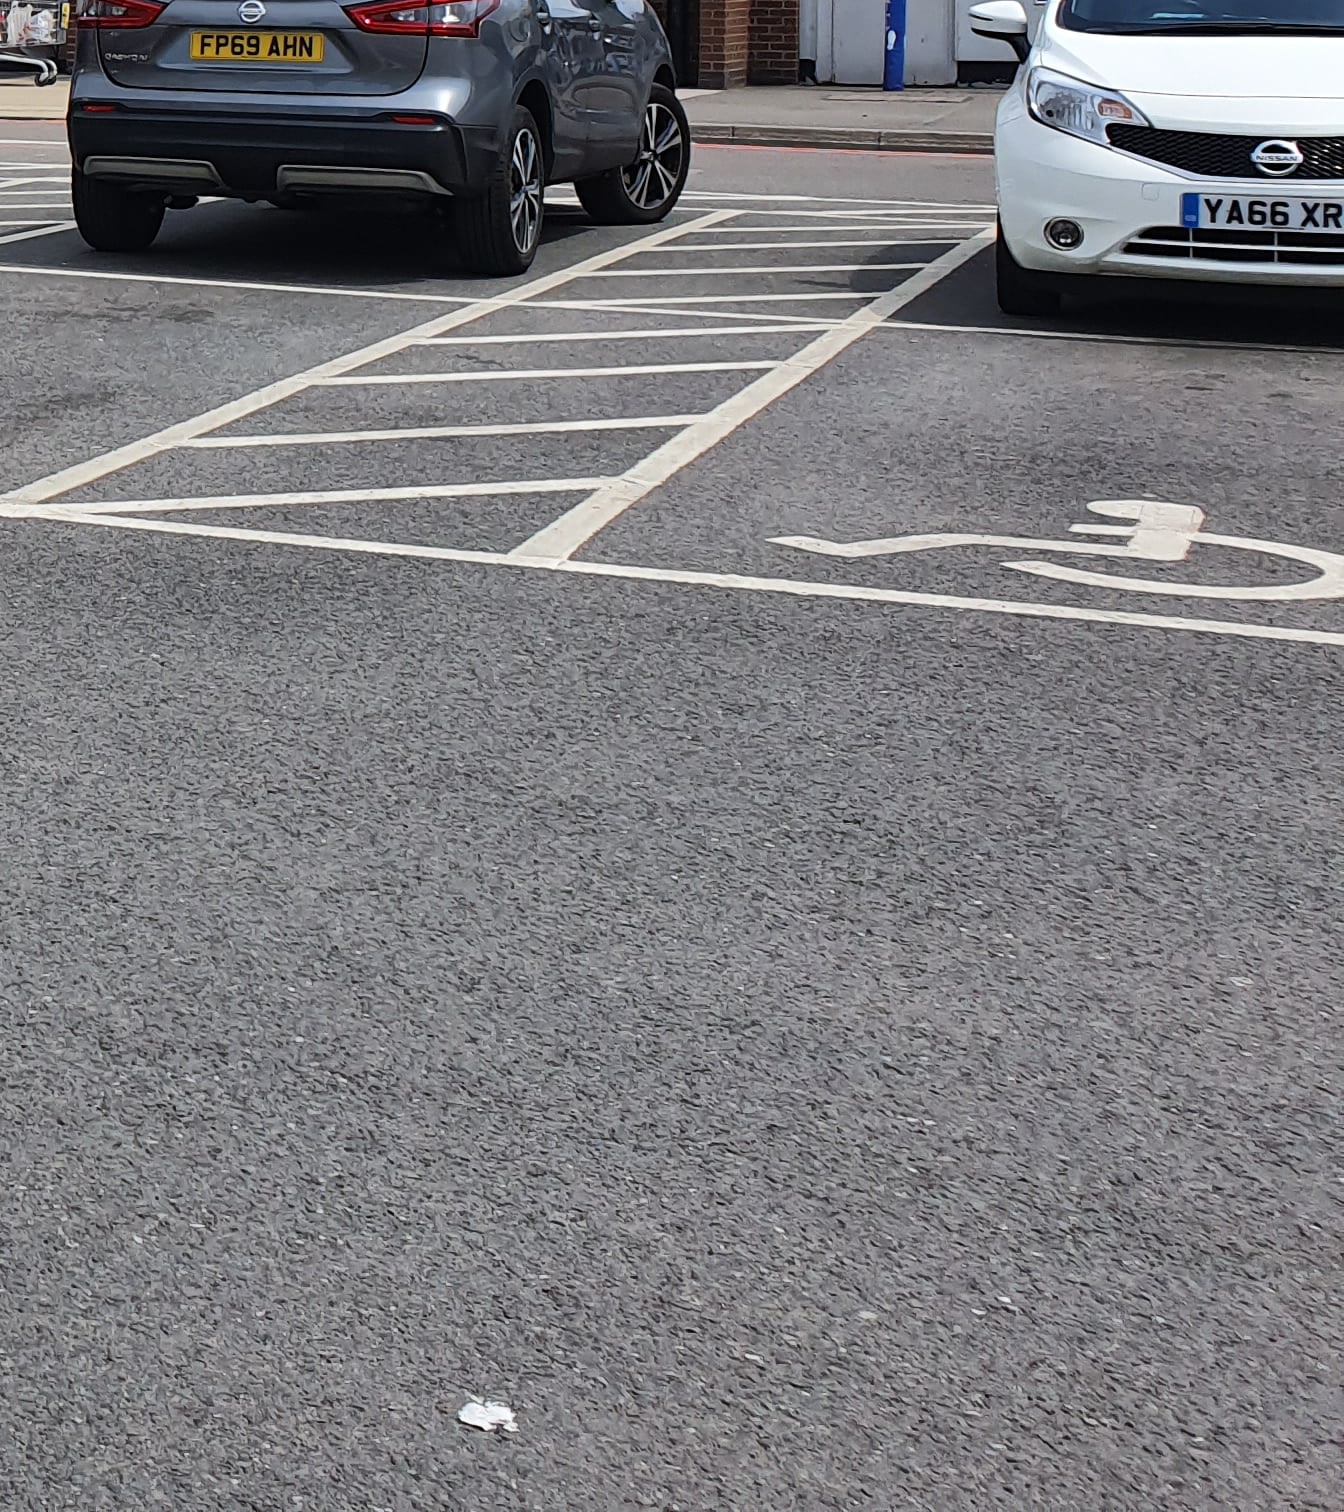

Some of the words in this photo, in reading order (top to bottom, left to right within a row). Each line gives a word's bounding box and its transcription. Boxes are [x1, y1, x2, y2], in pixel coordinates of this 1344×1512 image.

[200, 35, 260, 56] FP69
[267, 36, 313, 57] AHN
[1204, 198, 1289, 226] YA66
[1300, 202, 1344, 228] XR
